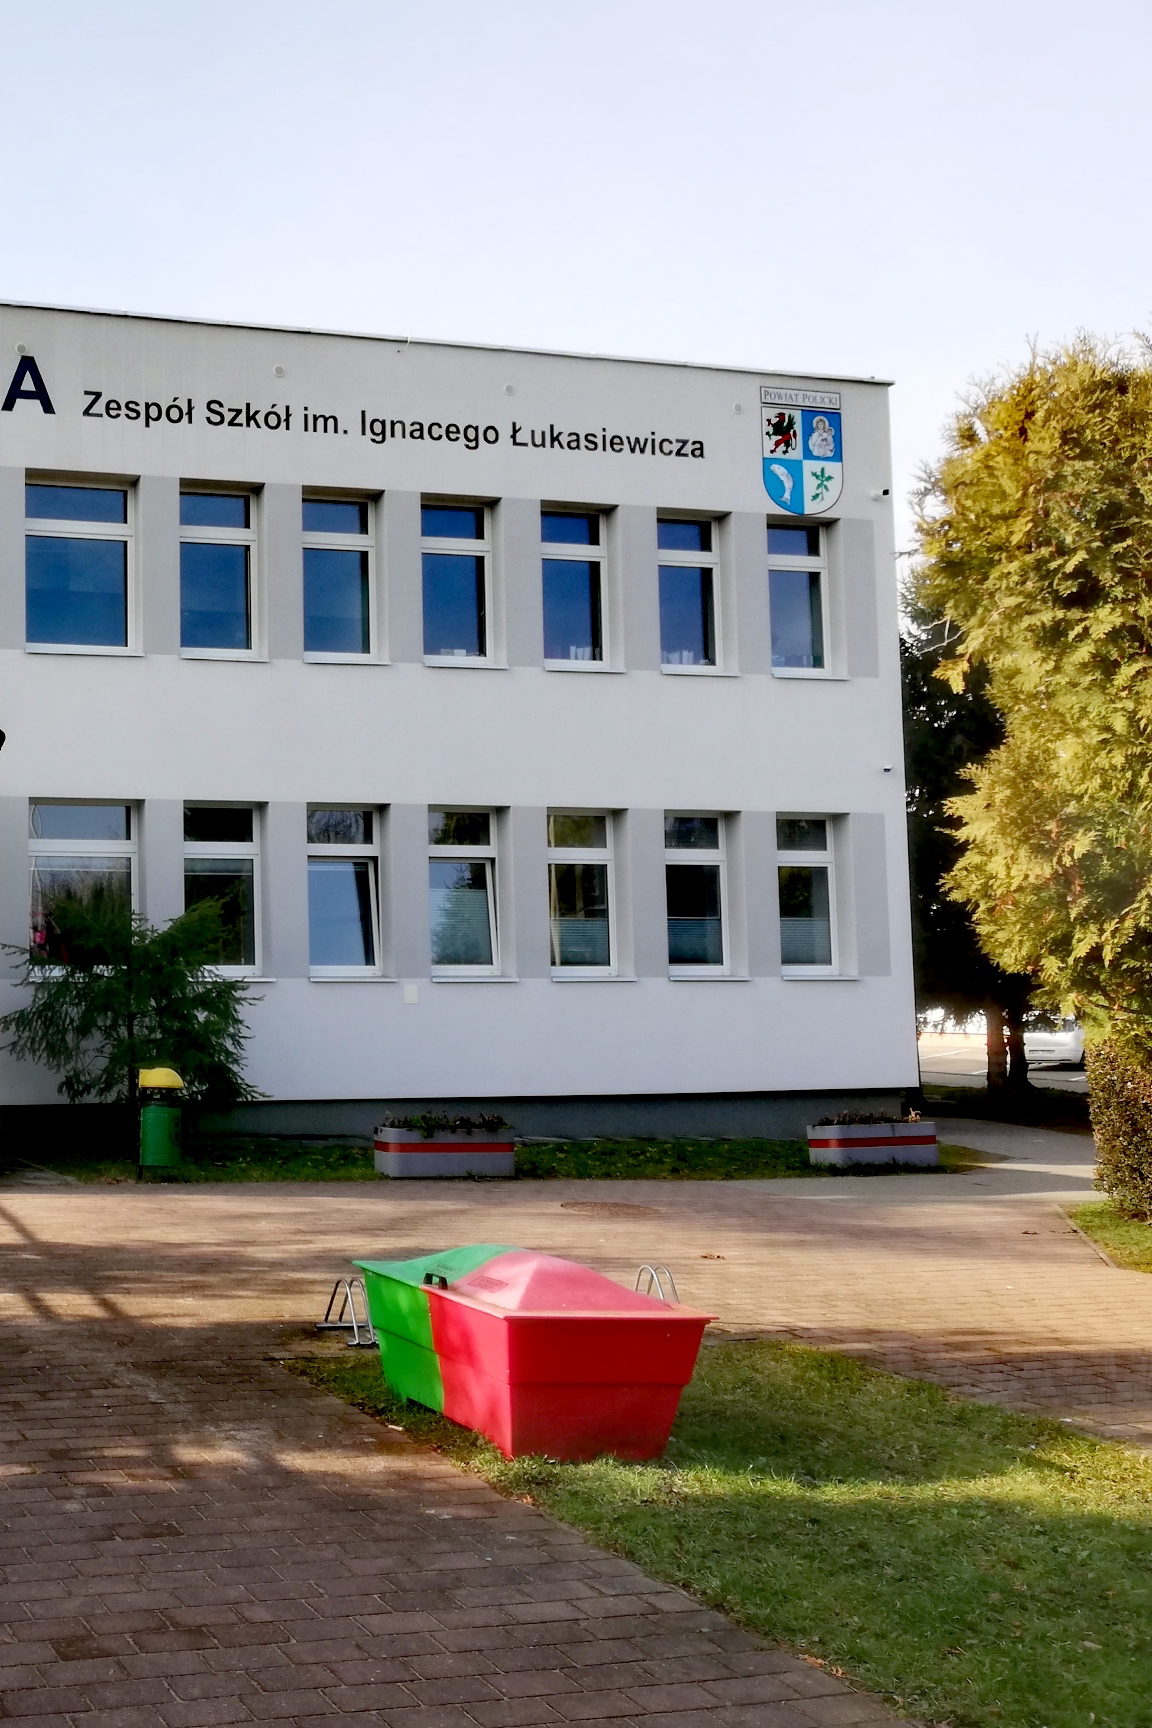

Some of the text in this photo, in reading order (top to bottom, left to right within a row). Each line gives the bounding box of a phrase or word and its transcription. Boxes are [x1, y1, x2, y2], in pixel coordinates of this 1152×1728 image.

[763, 389, 838, 406] POWIAT POLICKI
[82, 390, 706, 459] Zespół Szkół im. Ignacego Łukasiewicza
